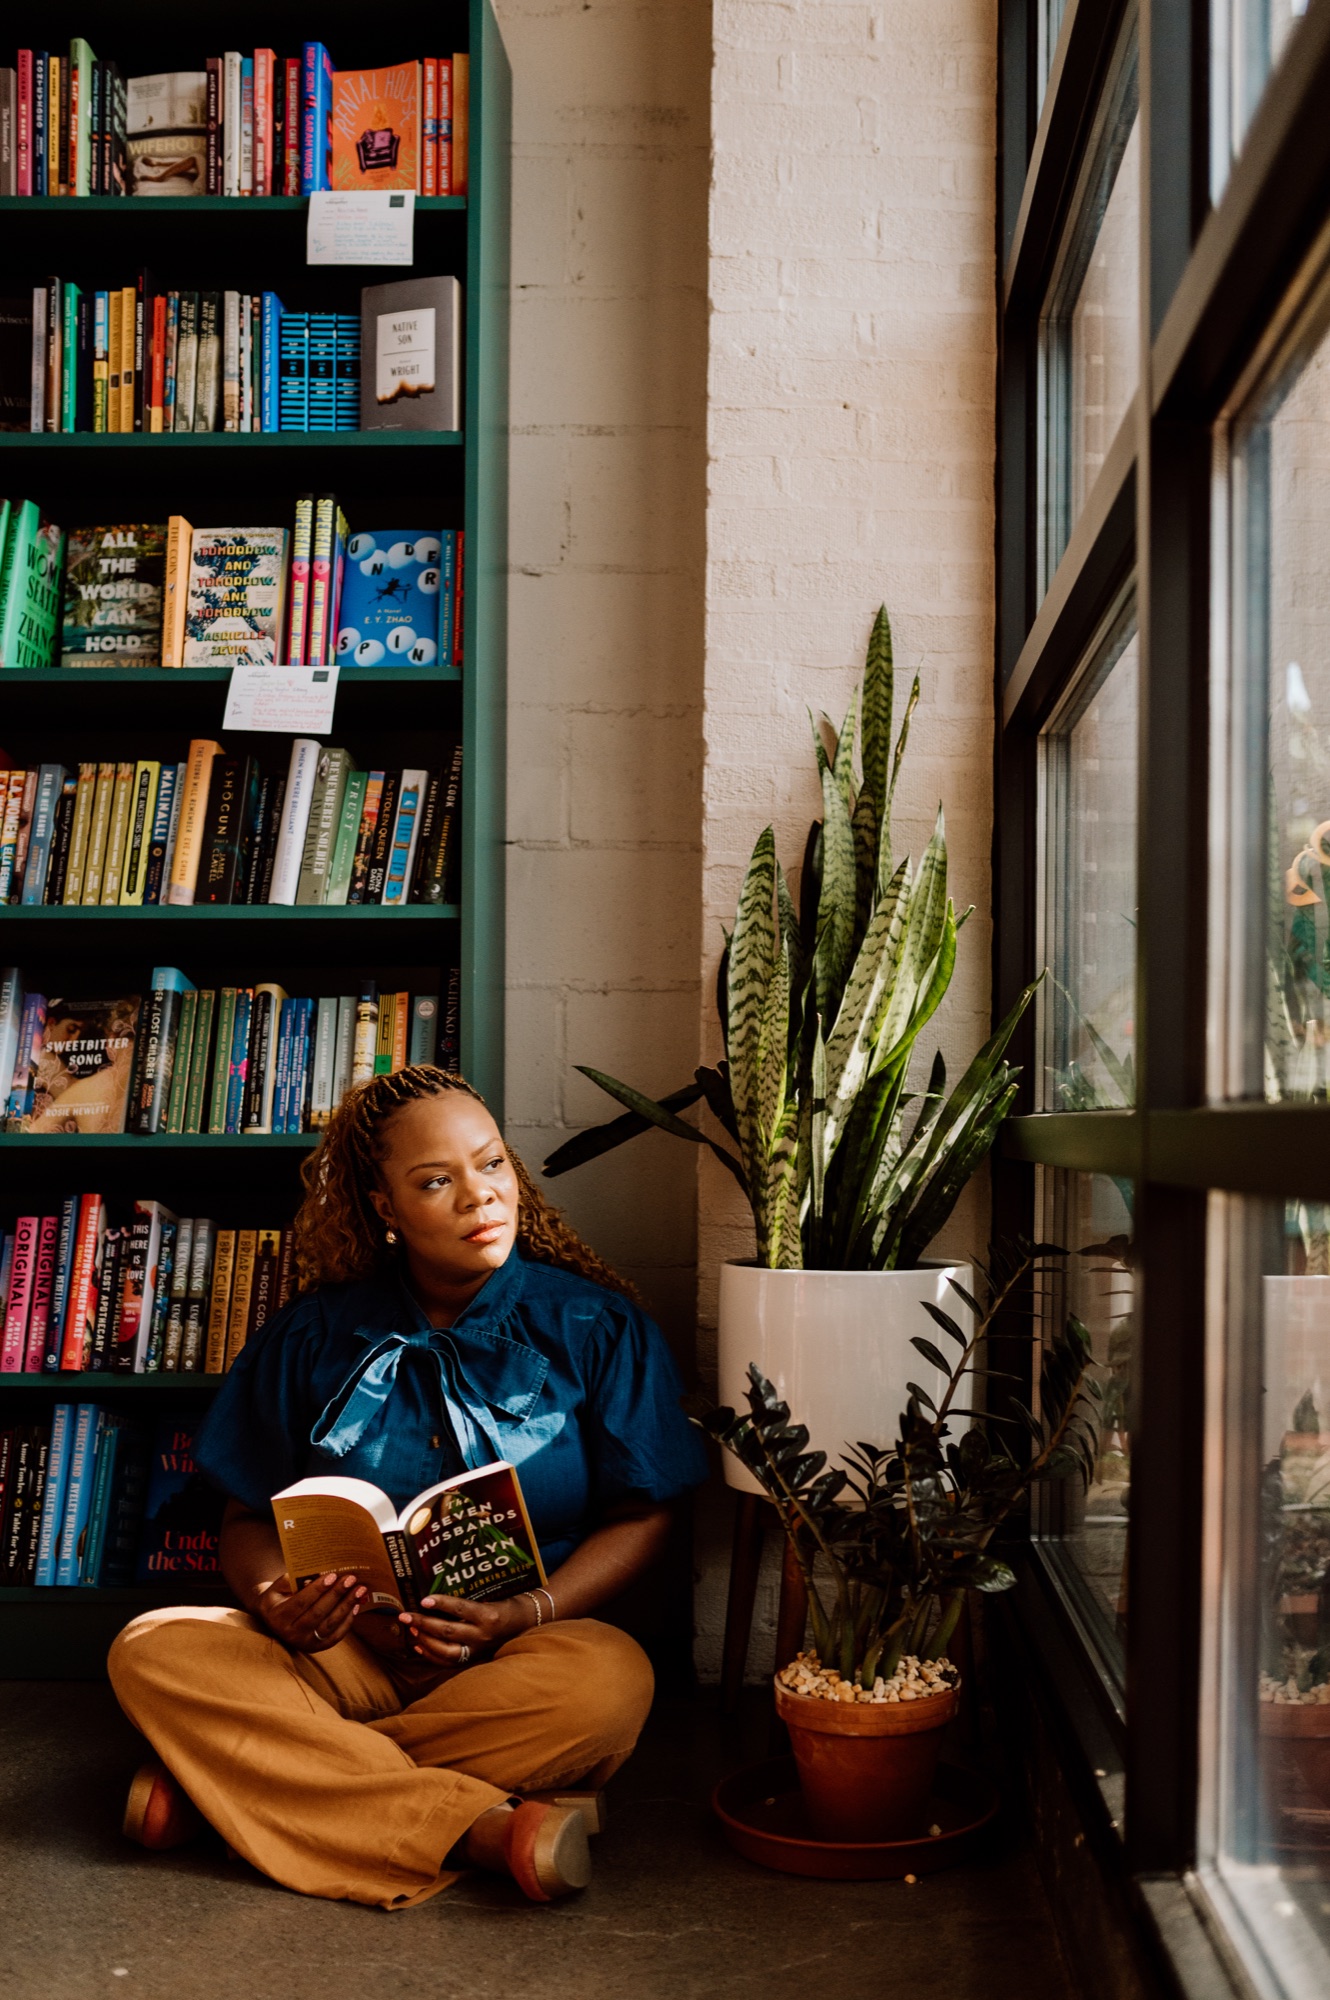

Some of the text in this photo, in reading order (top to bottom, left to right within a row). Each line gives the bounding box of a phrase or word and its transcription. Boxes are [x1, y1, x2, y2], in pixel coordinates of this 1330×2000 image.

[306, 46, 315, 92] NEW SKIN
[335, 72, 379, 140] RENTAL
[304, 114, 314, 179] SARAH WANG
[392, 320, 419, 332] NATIVE
[397, 336, 412, 345] SON
[390, 365, 420, 378] WRIGHT
[101, 532, 138, 548] ALL
[295, 499, 313, 556] SUPERFAN
[315, 499, 333, 556] SUPERFAN
[168, 526, 179, 575] THE COIN
[225, 561, 251, 570] AND
[99, 558, 137, 574] THE
[79, 582, 156, 600] WORLD
[222, 592, 248, 602] AND
[92, 609, 136, 626] CAN
[197, 608, 273, 617] TOMORROW
[85, 636, 142, 652] HOLD
[196, 631, 266, 641] GABRIELLE
[212, 646, 248, 655] ZEVIN
[288, 747, 307, 834] WHEN WE WERE BRILLIANT
[445, 745, 463, 807] FRIDA'S COOK
[6, 797, 22, 838] WOMEN
[35, 773, 53, 838] ALL IN HER HANDS
[133, 773, 149, 848] AND THE ANCESTORS SING
[154, 770, 175, 841] MALINALLI
[313, 761, 341, 874] REMEMBERED SOLDIER
[344, 781, 361, 830] TRUST
[381, 791, 394, 826] STOLEN
[423, 781, 438, 836] PARIS EXPRESS
[256, 810, 266, 834] COATES
[2, 846, 13, 865] ELLA
[376, 828, 387, 859] QUEEN
[209, 848, 220, 883] CLAVELL
[217, 853, 226, 880] JAMES
[368, 868, 378, 891] DAVIS
[374, 868, 384, 893] FIONA
[445, 968, 458, 1034] PACHINKO
[150, 1013, 161, 1035] LOST
[396, 1028, 402, 1040] WE
[46, 1038, 130, 1053] SWEETBITTER
[69, 1054, 103, 1066] SONG
[146, 1037, 158, 1079] CHILDREN
[320, 1041, 328, 1078] LIBRARIAN
[46, 1105, 110, 1117] ROSIE HEWLETT
[133, 1225, 149, 1234] THIS
[180, 1225, 190, 1239] THE
[198, 1225, 209, 1239] THE
[130, 1240, 148, 1250] HERE
[133, 1255, 141, 1264] IS
[238, 1241, 251, 1271] BRIAR
[10, 1229, 31, 1310] ORIGINAL
[35, 1229, 56, 1310] ORIGINAL
[73, 1206, 98, 1339] WHEN SLEEPING WOMEN WAKE
[127, 1270, 144, 1280] LOVE
[155, 1229, 172, 1304] The Berry Pickers
[210, 1241, 231, 1362] BRIAR CLUB KATE QUINN
[235, 1274, 247, 1302] CLUB
[258, 1275, 269, 1301] ROSE
[94, 1270, 112, 1352] LOST APOTHECARY
[232, 1309, 242, 1328] KATE
[5, 1317, 15, 1351] PARMAR
[12, 1322, 22, 1347] PRIYA
[30, 1316, 41, 1352] PARMAR
[37, 1321, 47, 1346] PRIYA
[52, 1418, 64, 1451] PERFECT
[75, 1418, 87, 1451] PERFECT
[16, 1442, 29, 1494] Amor Towles
[35, 1445, 48, 1497] Amor Towles
[49, 1453, 61, 1477] HAND
[72, 1453, 84, 1477] HAND
[430, 1501, 493, 1532] SEVEN
[446, 1497, 470, 1509] The
[39, 1483, 57, 1560] AYELET WALDMAN
[61, 1483, 80, 1560] AYELET WALDMAN
[284, 1519, 295, 1529] R
[418, 1509, 517, 1558] HUSBANDS
[8, 1512, 22, 1567] Table for Two
[27, 1515, 40, 1570] Table for Two
[398, 1539, 406, 1552] SEVEN
[463, 1534, 476, 1545] of
[148, 1551, 224, 1571] the Sta
[386, 1535, 405, 1577] EVELYN HUGO
[432, 1537, 515, 1575] EVELYN
[445, 1556, 510, 1586] HUGO
